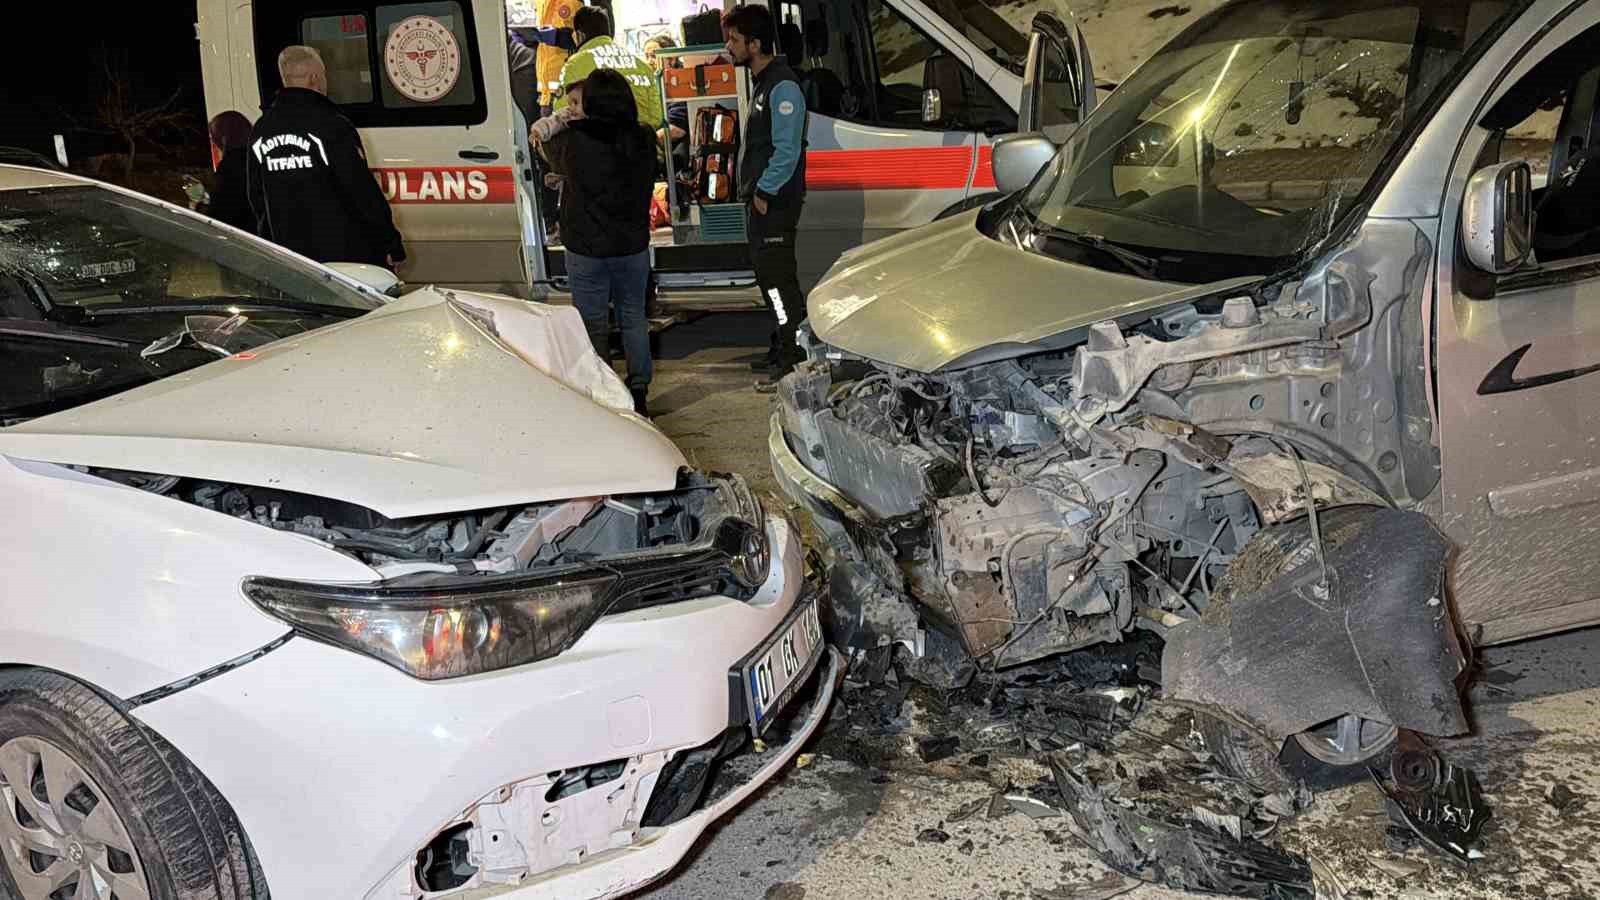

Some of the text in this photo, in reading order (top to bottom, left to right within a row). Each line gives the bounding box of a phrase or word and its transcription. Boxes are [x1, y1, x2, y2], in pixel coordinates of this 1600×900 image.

[260, 134, 311, 155] ADIYAMAN
[757, 656, 775, 705] 01
[782, 629, 800, 678] GK
